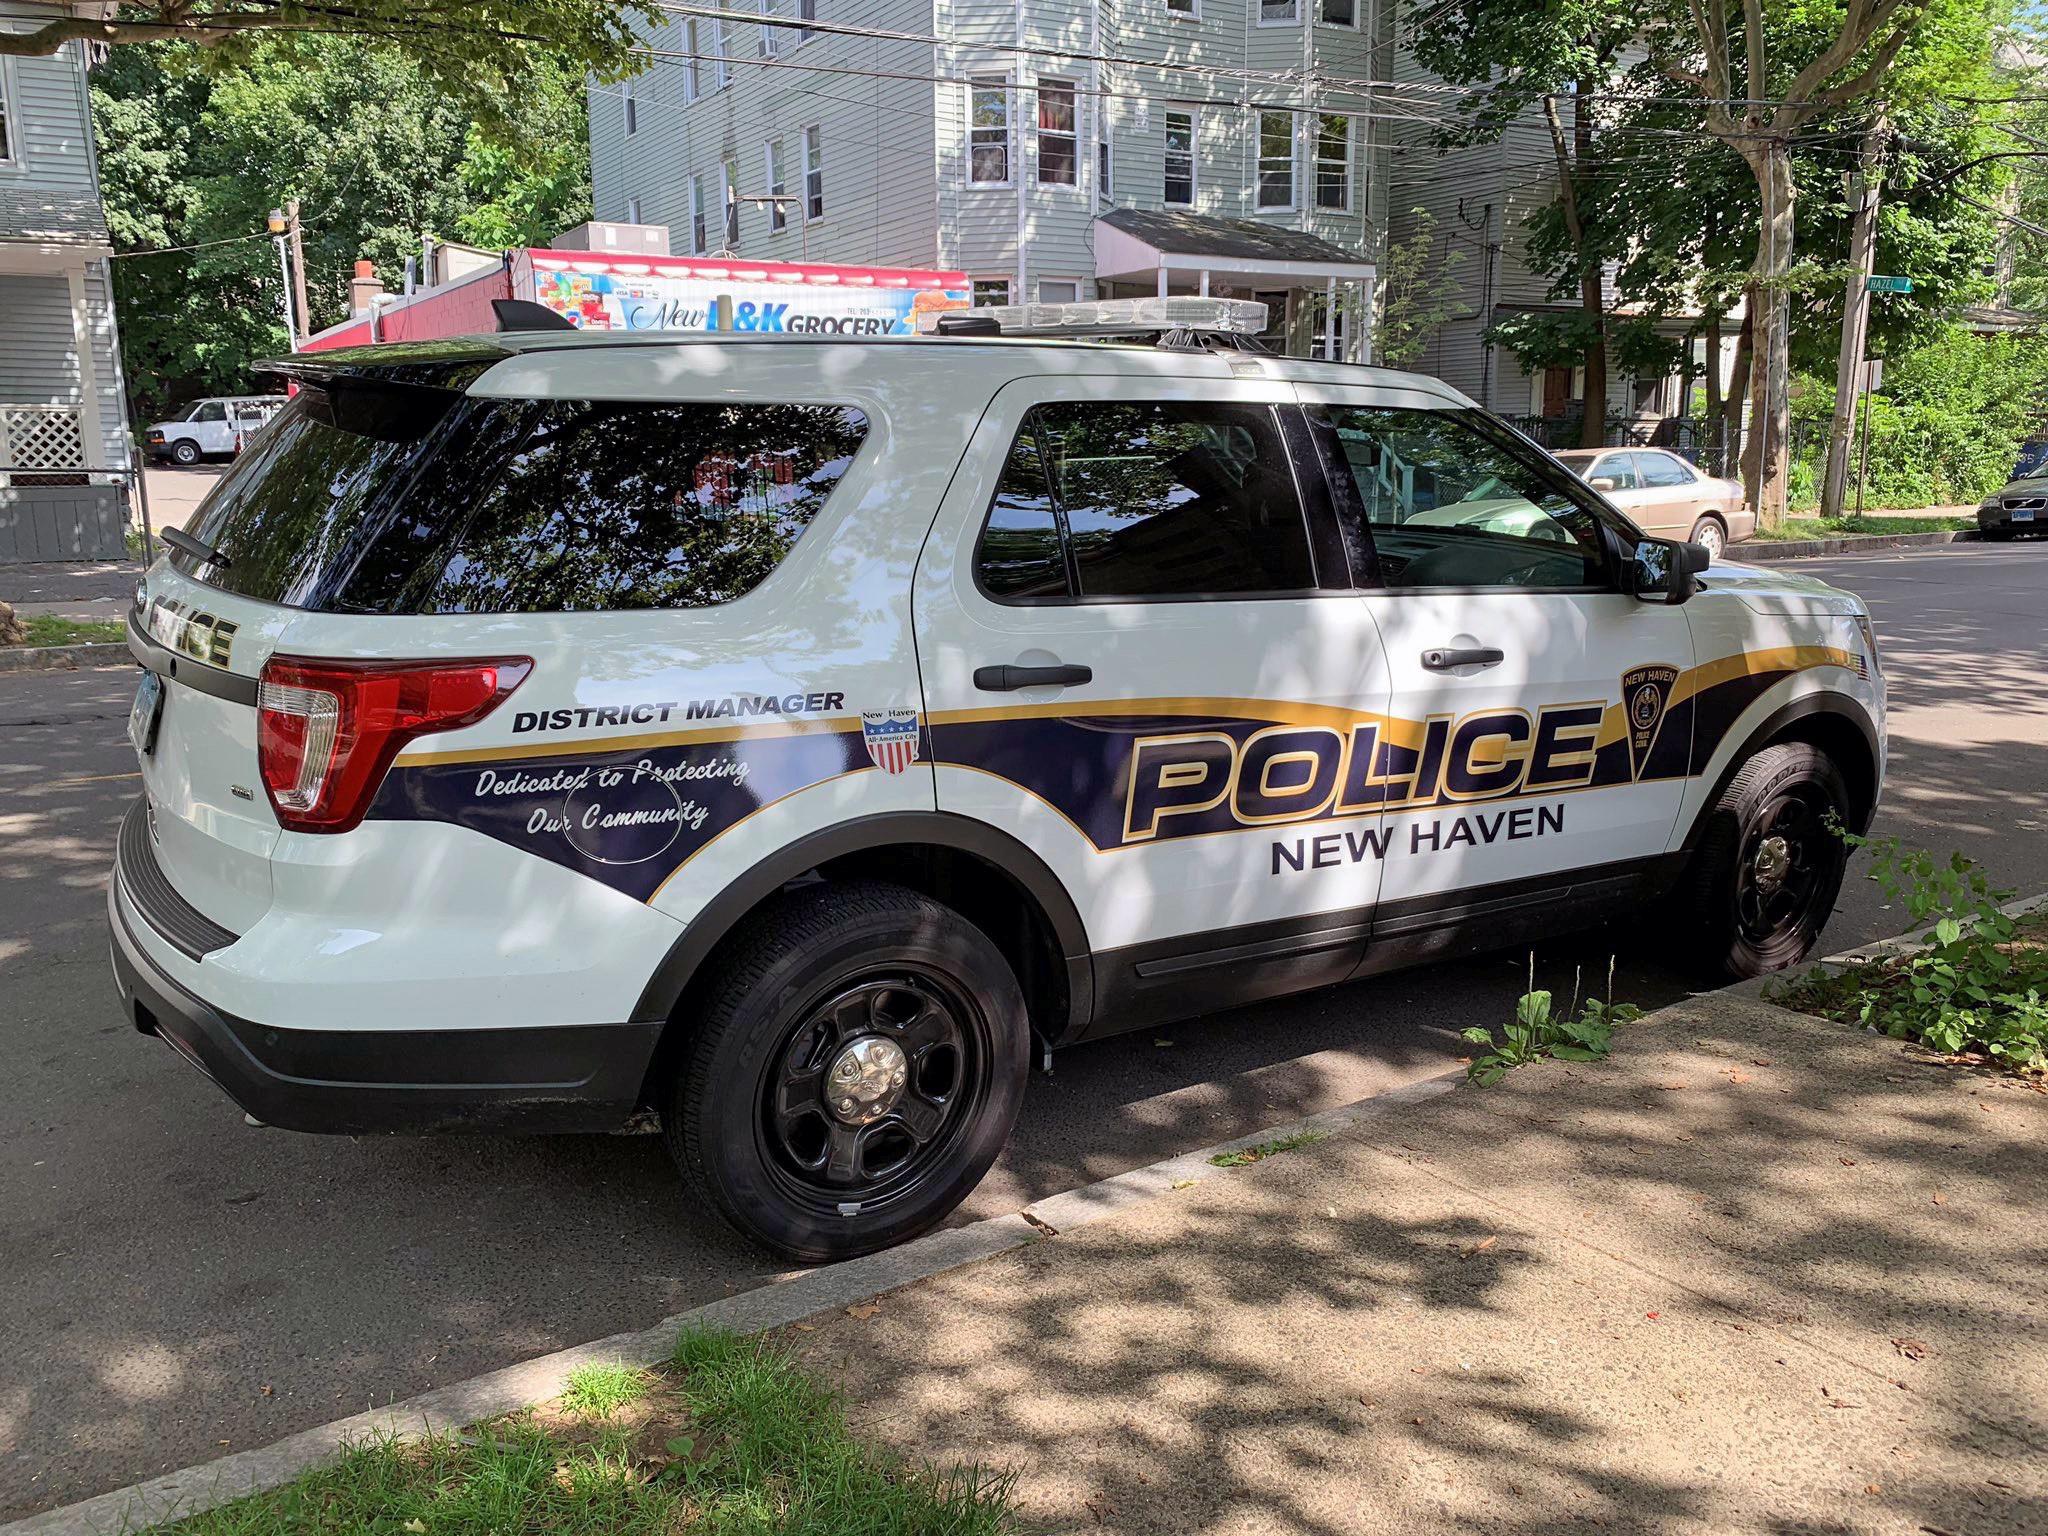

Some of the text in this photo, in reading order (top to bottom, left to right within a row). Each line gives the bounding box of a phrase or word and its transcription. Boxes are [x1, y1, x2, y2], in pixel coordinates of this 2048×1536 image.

[1870, 278, 1895, 289] HAZEL
[630, 299, 705, 330] New
[786, 315, 896, 335] GROCERY
[1625, 670, 1676, 687] NEW HAVEN
[512, 692, 845, 733] DISTRICT MANAGER
[862, 709, 916, 719] New Haven
[474, 758, 751, 797] Dedicated to Protecting
[1122, 700, 1607, 843] POLICE
[526, 800, 710, 834] Our Community
[1271, 803, 1565, 875] NEW HAVEN
